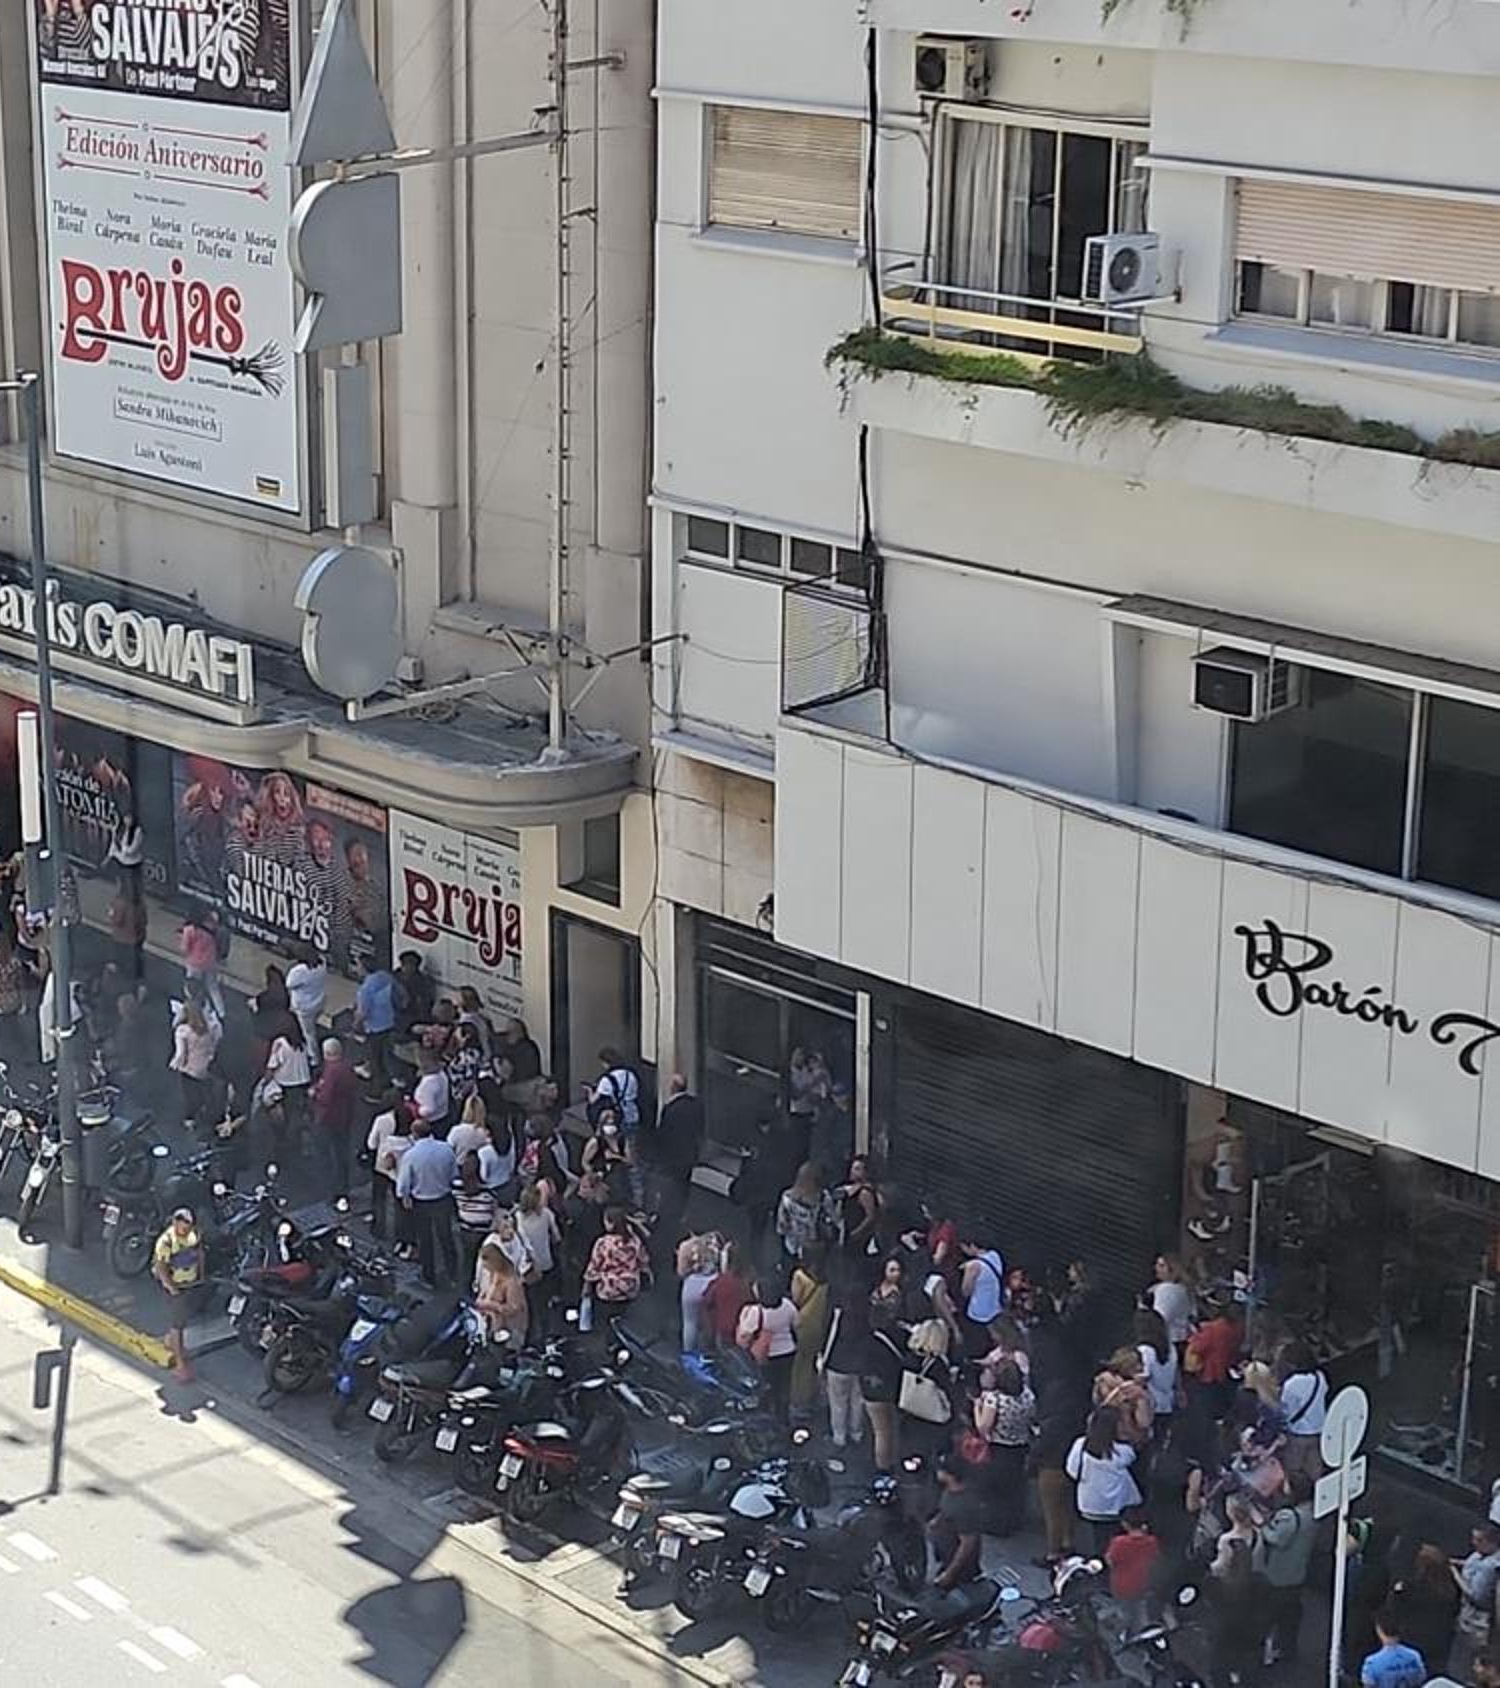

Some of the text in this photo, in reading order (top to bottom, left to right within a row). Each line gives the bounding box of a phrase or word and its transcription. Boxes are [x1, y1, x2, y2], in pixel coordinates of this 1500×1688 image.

[91, 4, 241, 88] SALVAJES
[66, 126, 263, 178] Edición Aniversario
[52, 200, 87, 218] Thelma
[191, 222, 237, 243] Graciela
[95, 223, 140, 244] Cárpena
[247, 248, 273, 266] Leal
[60, 259, 244, 381] Brujas
[117, 399, 151, 419] Sandra
[84, 601, 254, 705] COMAFI
[242, 851, 307, 899] TIJERAS
[227, 873, 330, 951] SALVAJES
[1233, 918, 1419, 1034] Barón
